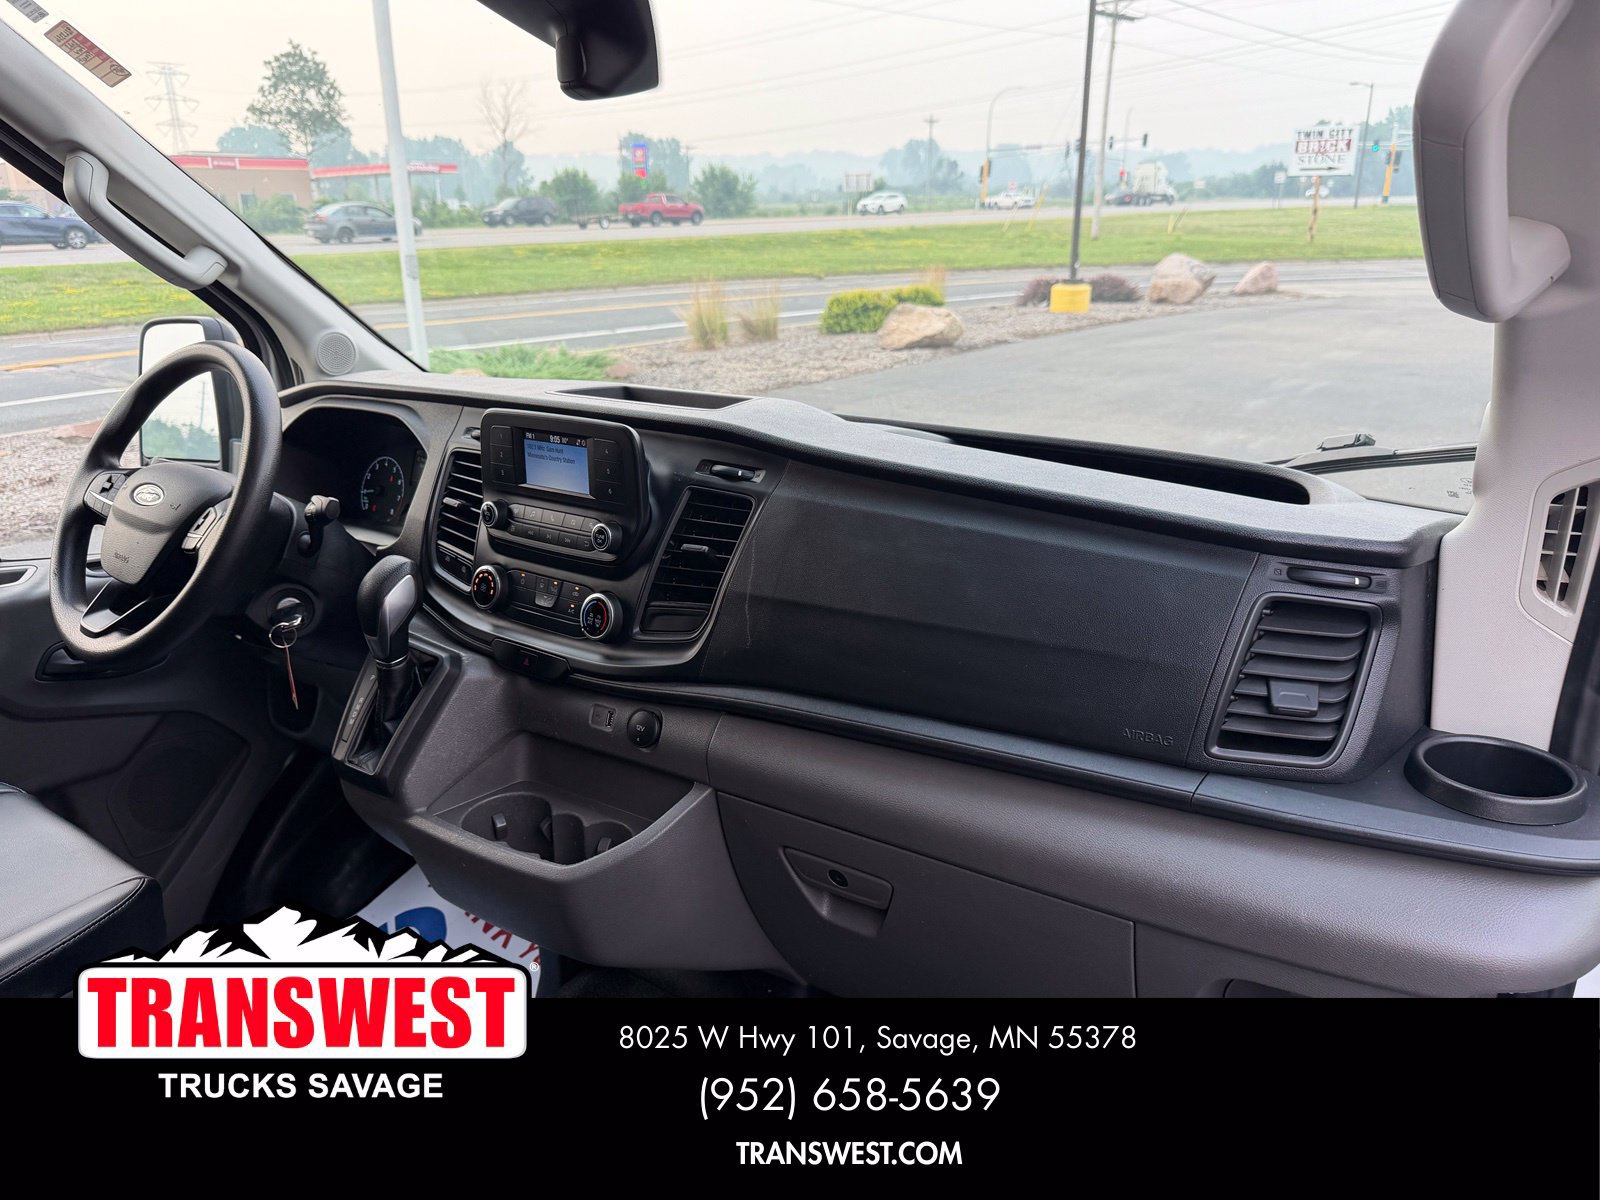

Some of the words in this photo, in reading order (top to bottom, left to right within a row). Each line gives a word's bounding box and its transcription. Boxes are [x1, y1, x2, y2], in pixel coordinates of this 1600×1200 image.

[1297, 129, 1323, 139] TWIN
[1329, 128, 1353, 138] CITY
[1297, 139, 1351, 154] BRICK
[1297, 155, 1345, 165] STONE
[550, 434, 560, 444] 9:05
[1123, 728, 1174, 747] AIRBAG
